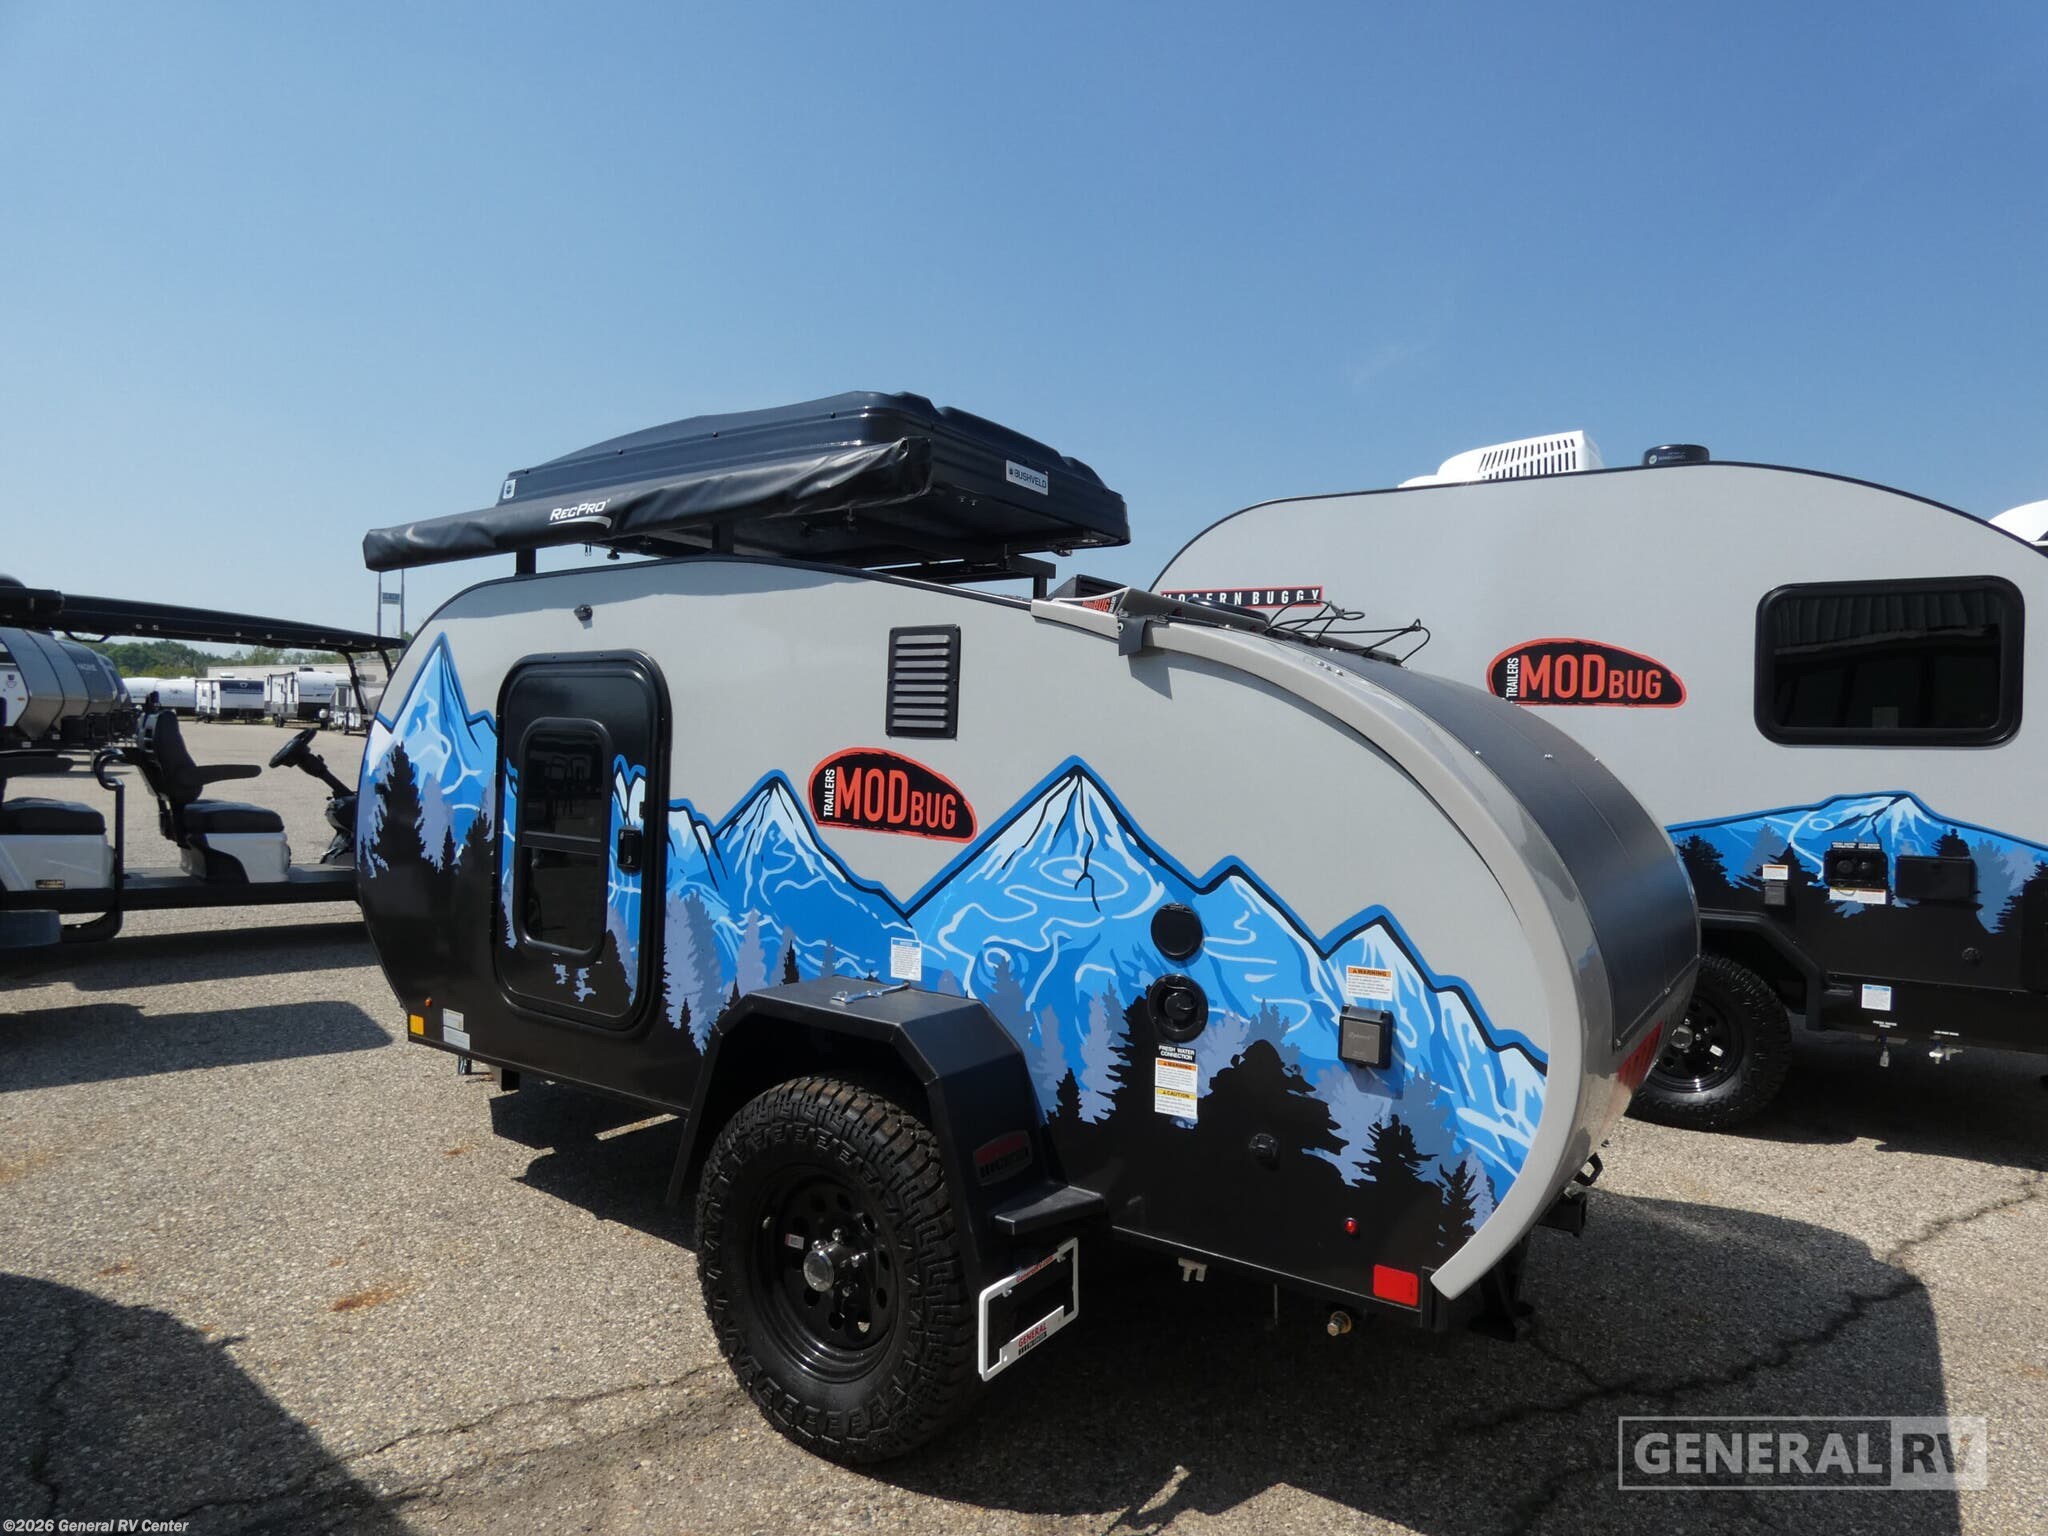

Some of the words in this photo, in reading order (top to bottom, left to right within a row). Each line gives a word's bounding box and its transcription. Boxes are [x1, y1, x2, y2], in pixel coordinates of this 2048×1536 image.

[1162, 592, 1242, 606] OERN
[1252, 589, 1320, 605] BUGGY
[1506, 657, 1519, 698] TRAILERS
[823, 768, 836, 817] TRAILERS
[1158, 1044, 1176, 1053] FRESH
[1177, 1047, 1195, 1056] WATER
[1160, 1050, 1193, 1060] CONNECTION
[1167, 1091, 1190, 1099] CAUTION
